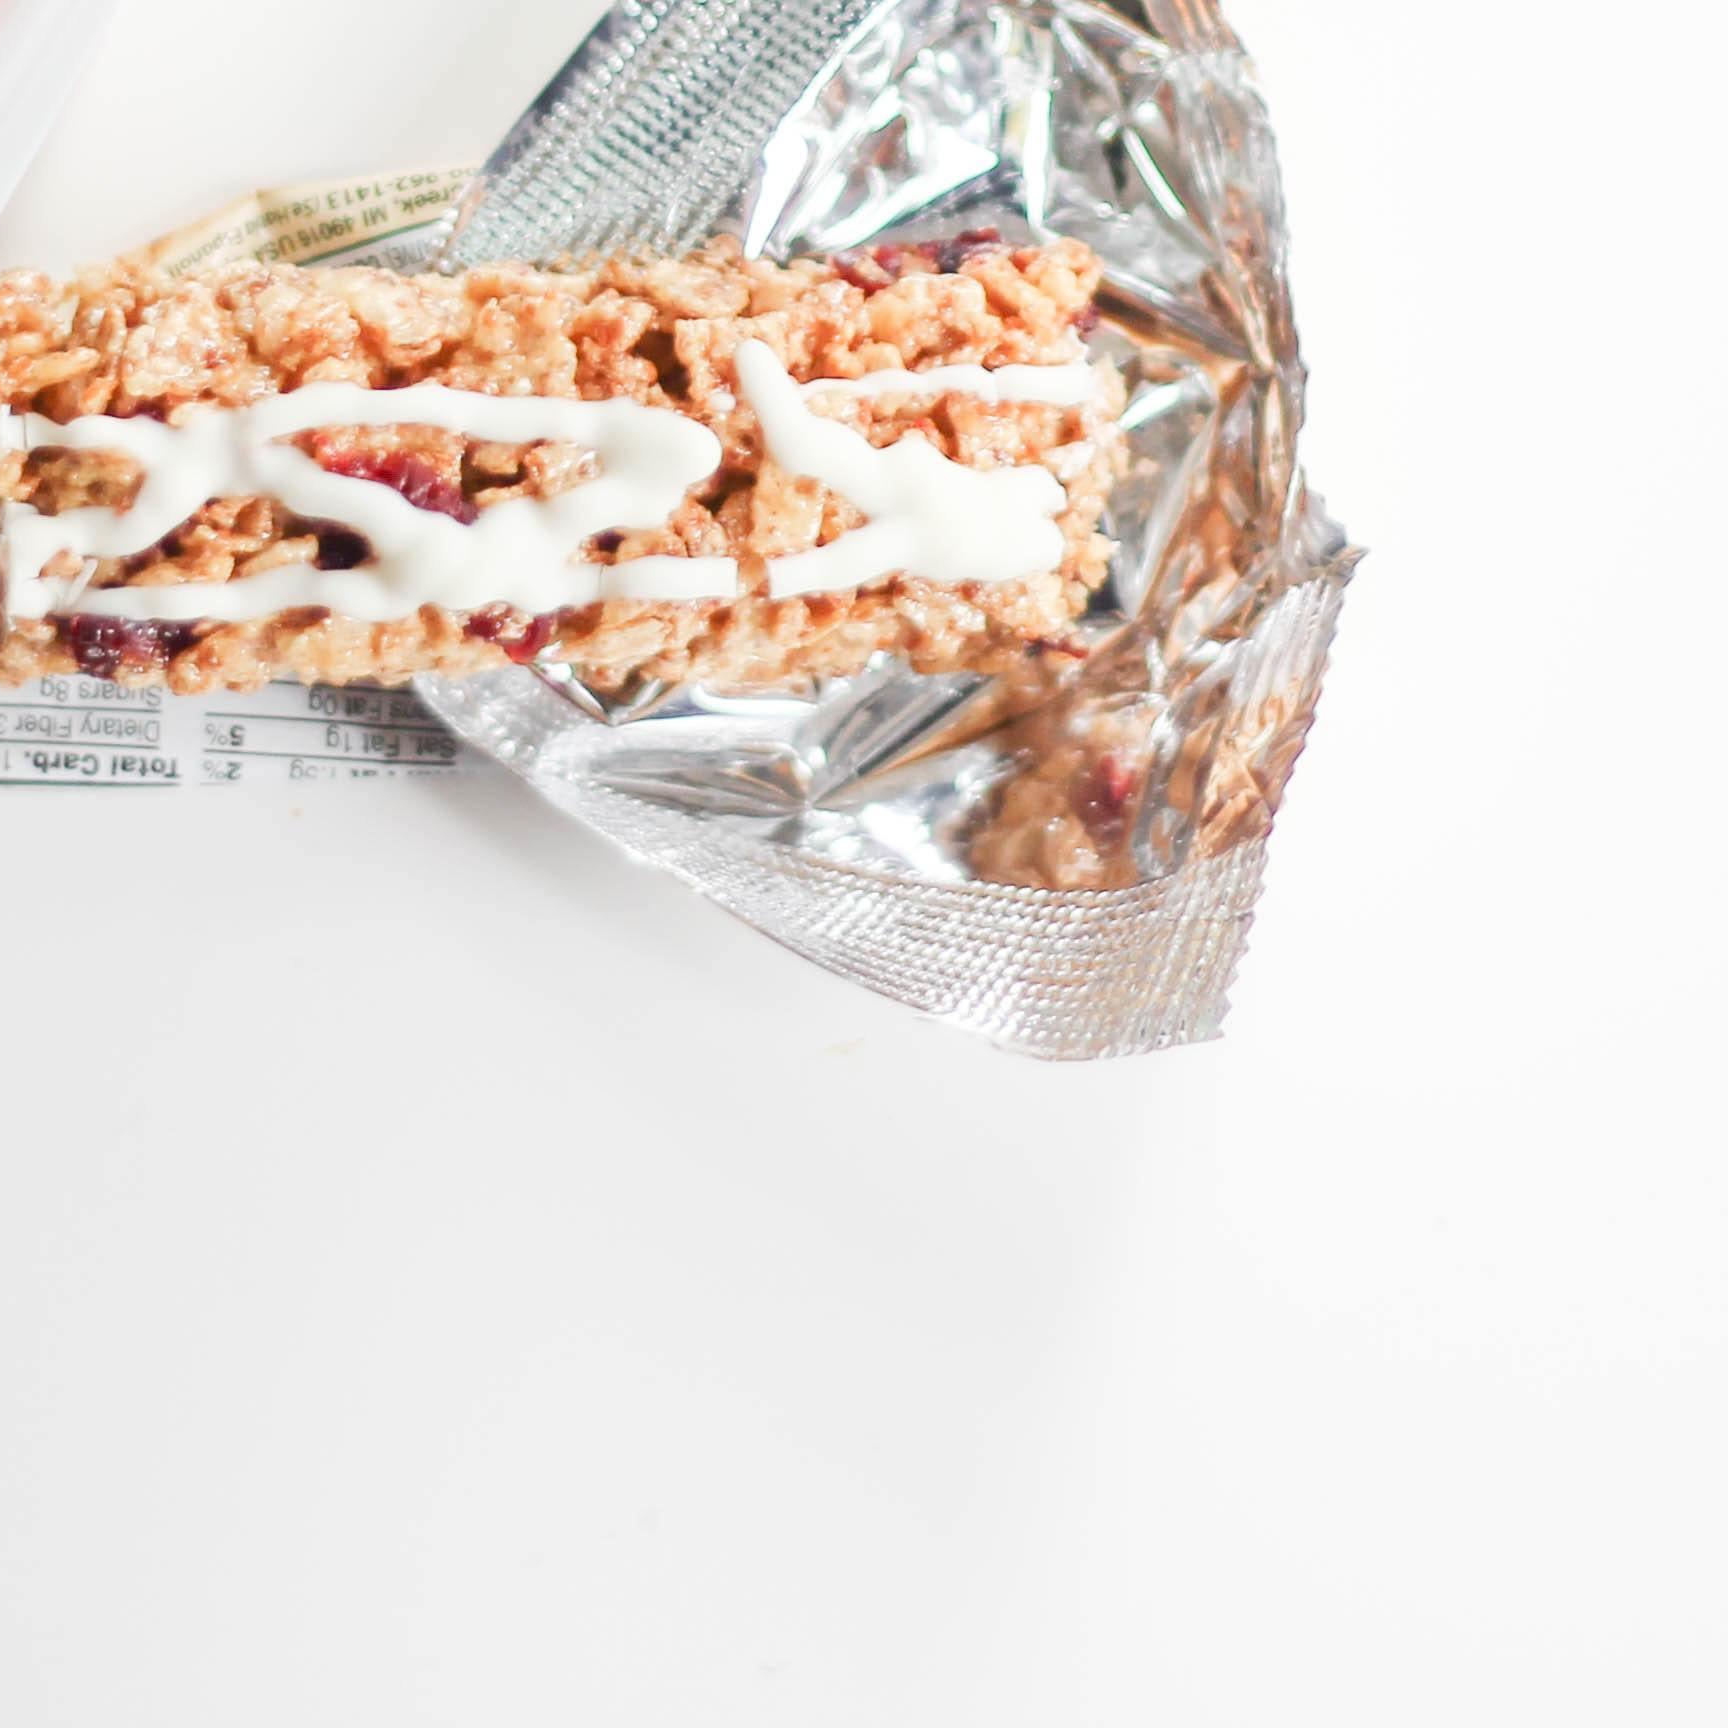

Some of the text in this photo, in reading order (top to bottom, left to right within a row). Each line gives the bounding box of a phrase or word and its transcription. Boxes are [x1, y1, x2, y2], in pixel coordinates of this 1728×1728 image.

[361, 207, 388, 227] MI
[39, 675, 70, 702] 8g
[308, 688, 338, 714] 0g
[14, 714, 73, 739] Fiber
[80, 711, 161, 743] Dietary
[204, 723, 246, 747] 5%
[326, 724, 352, 753] 1g
[361, 732, 400, 758] Fat
[24, 750, 100, 776] Carb.
[111, 754, 181, 779] Total
[202, 759, 243, 782] 2%
